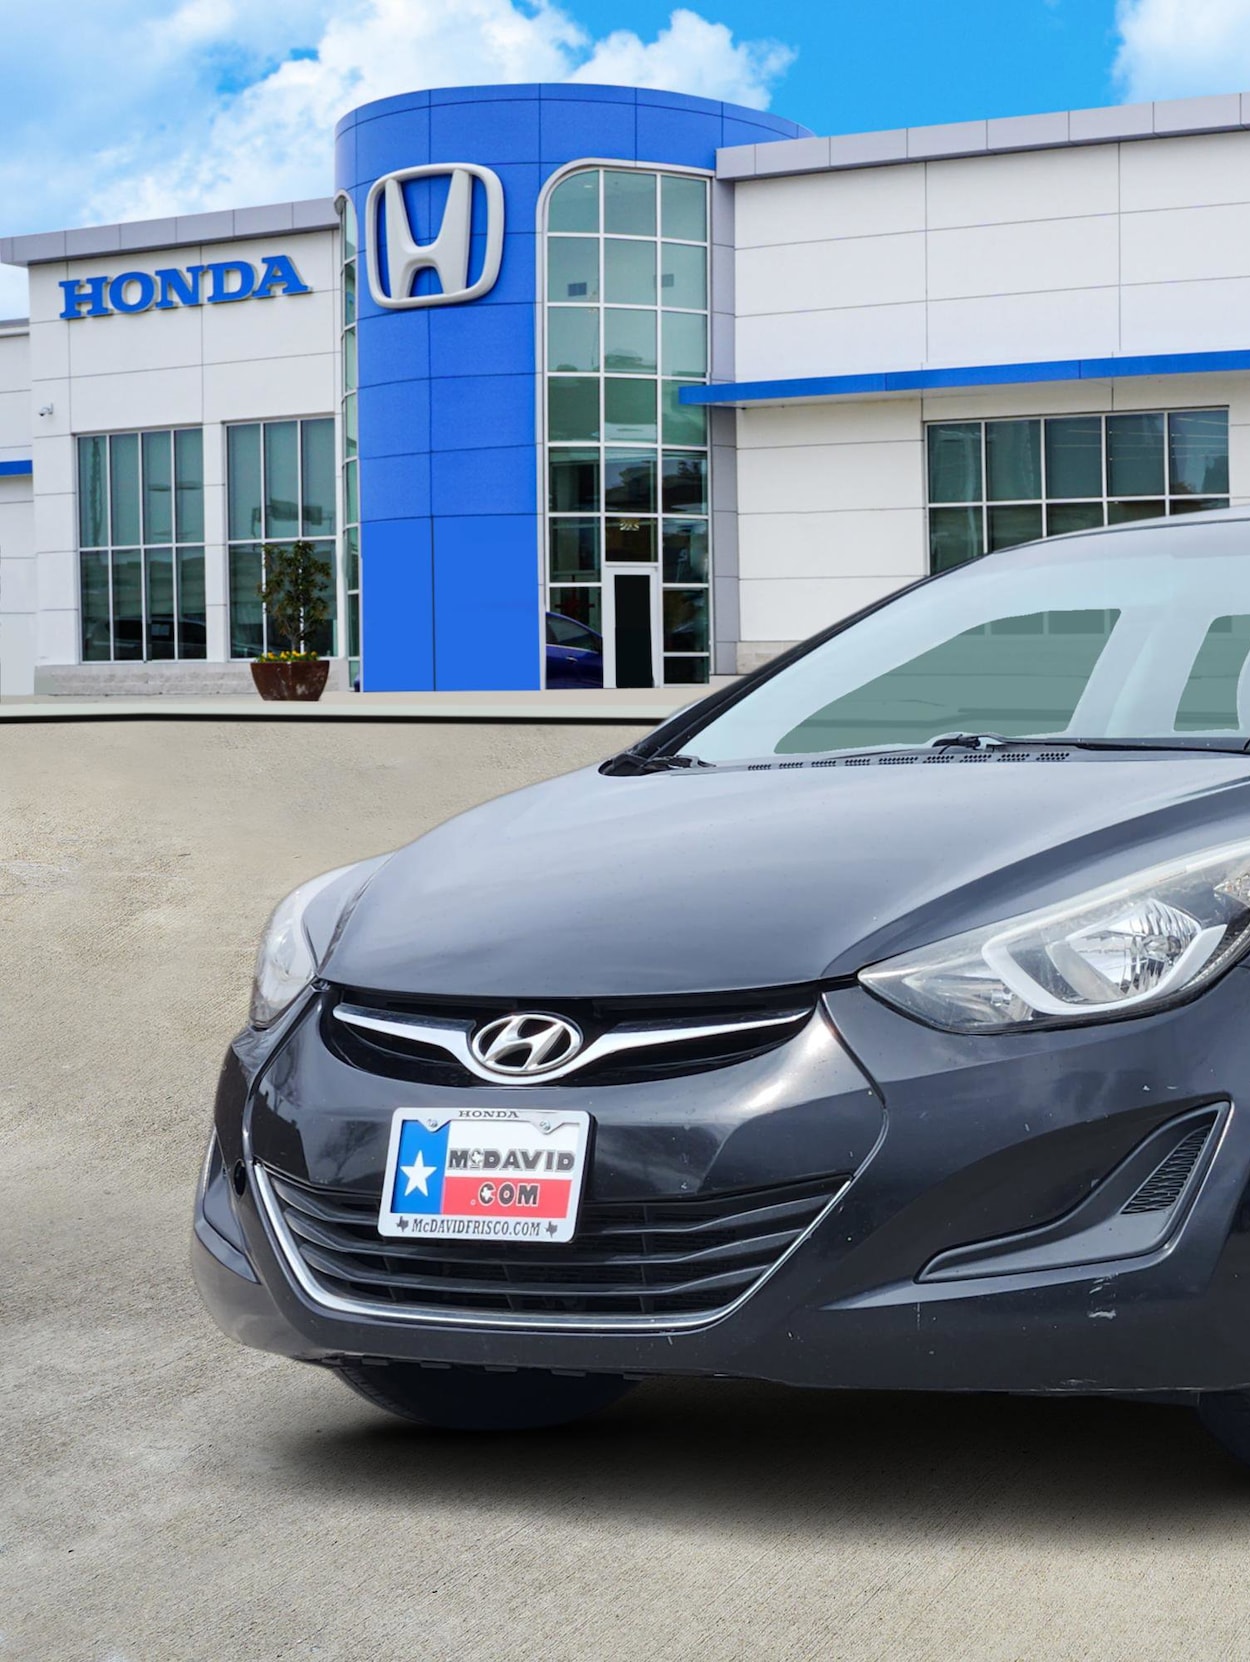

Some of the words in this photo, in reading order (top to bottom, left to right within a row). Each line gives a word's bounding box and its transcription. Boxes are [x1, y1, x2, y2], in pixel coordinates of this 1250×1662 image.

[58, 254, 310, 320] HONDA
[458, 1109, 520, 1119] HONDA
[411, 1218, 541, 1237] McDAVIDFRISCO.COM
